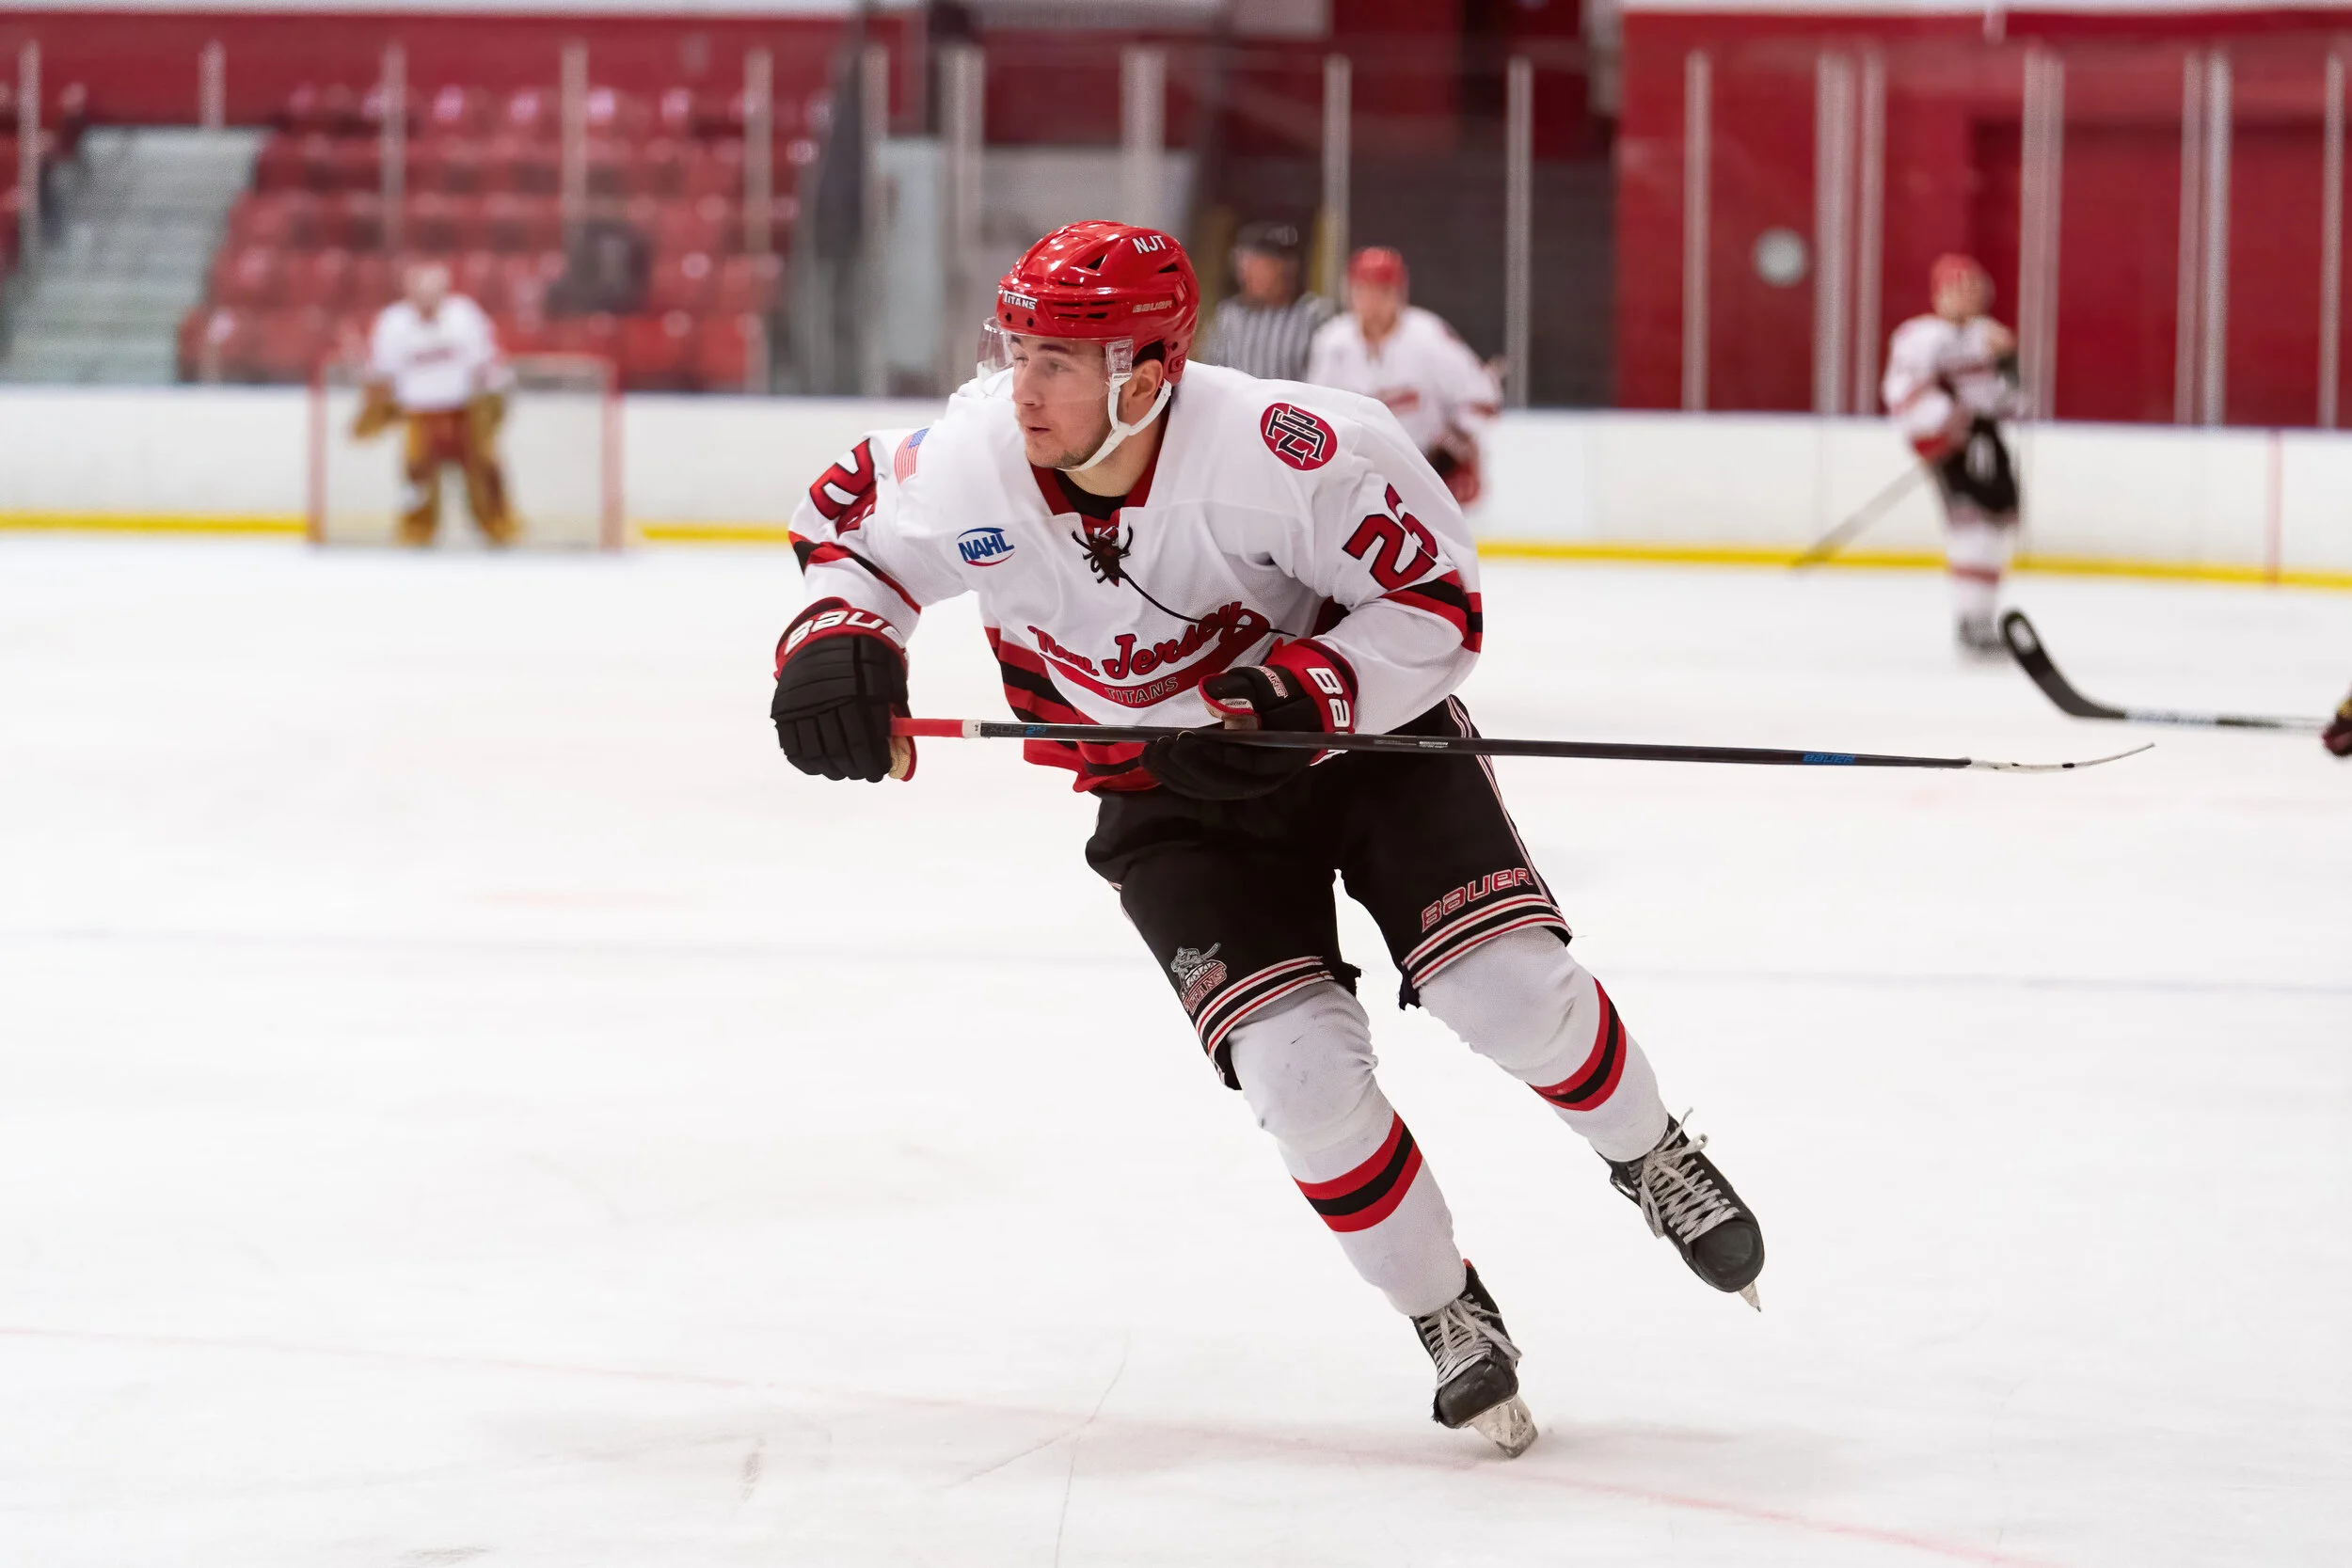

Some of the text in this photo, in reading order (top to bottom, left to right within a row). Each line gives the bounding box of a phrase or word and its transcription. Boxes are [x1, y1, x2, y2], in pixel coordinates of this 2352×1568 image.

[1132, 235, 1167, 254] NJT
[1003, 290, 1038, 310] TITANS
[958, 532, 1015, 562] NAHL
[1102, 601, 1271, 680] Jersey
[1105, 677, 1179, 704] TITANS
[1422, 867, 1534, 933] BAUER
